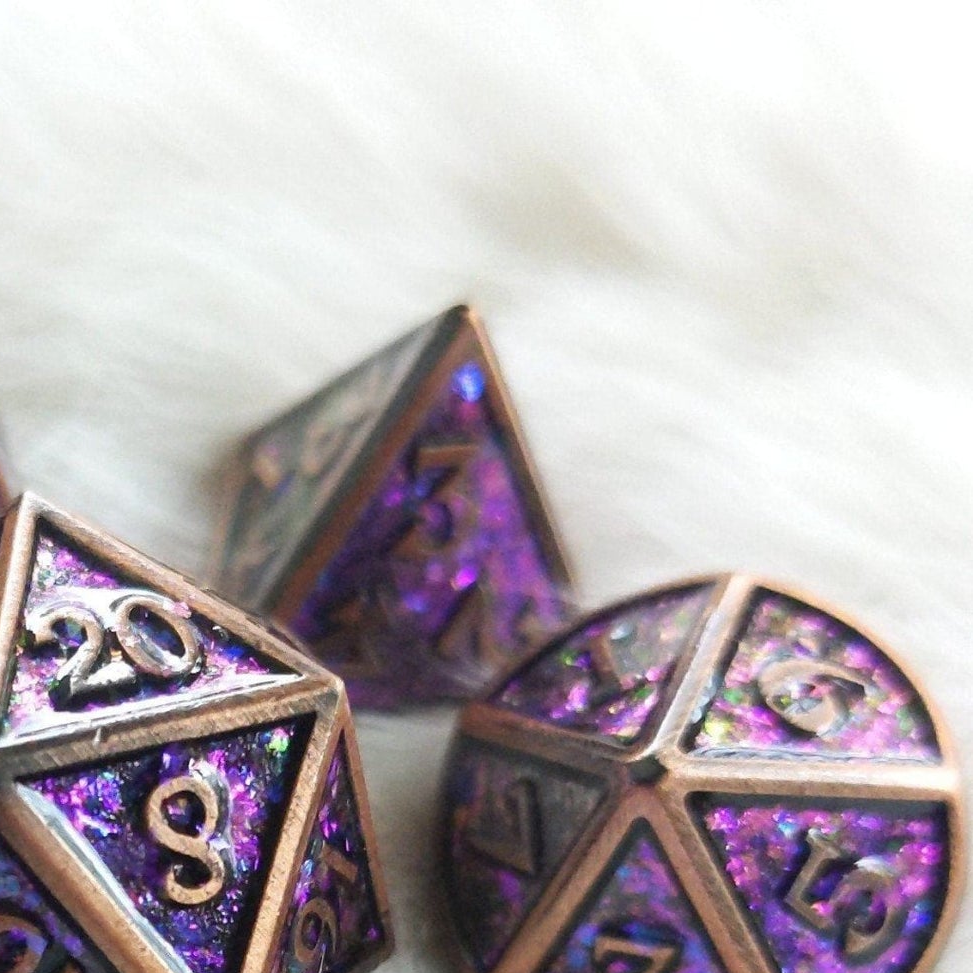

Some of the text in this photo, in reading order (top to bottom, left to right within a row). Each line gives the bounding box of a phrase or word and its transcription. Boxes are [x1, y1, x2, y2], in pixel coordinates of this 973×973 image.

[29, 592, 205, 704] 20
[143, 774, 225, 905] 8
[784, 829, 907, 967] 5
